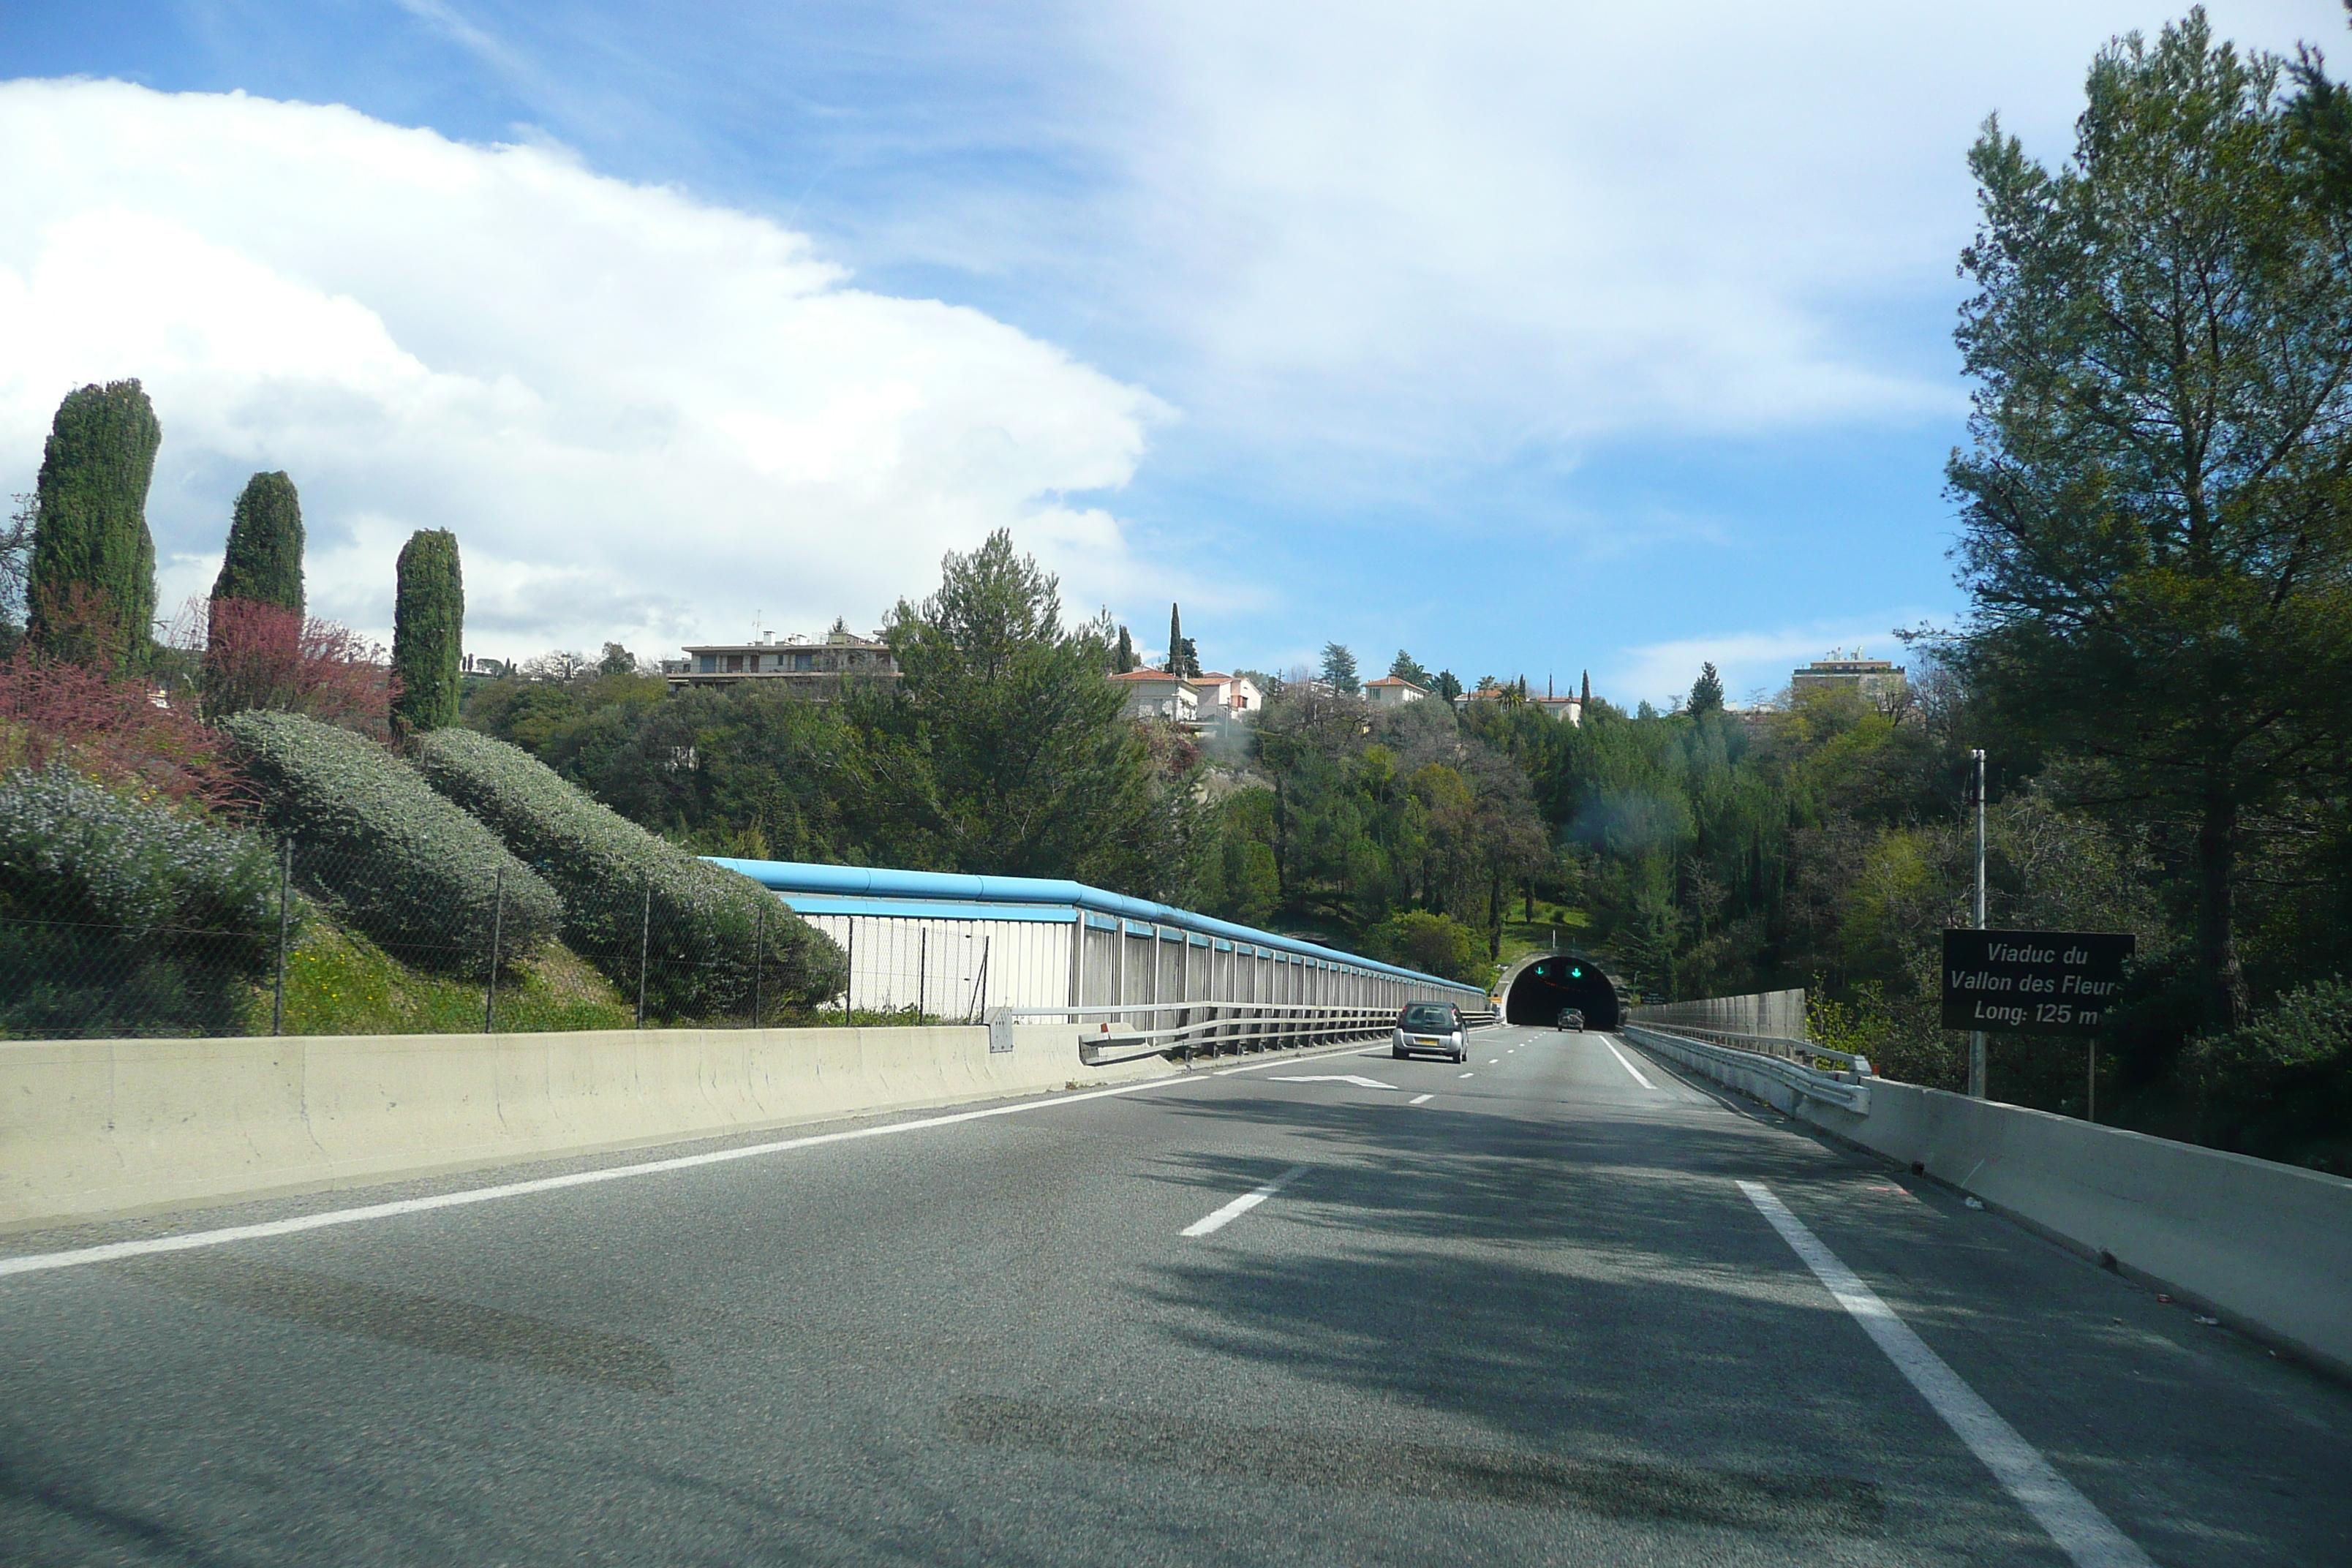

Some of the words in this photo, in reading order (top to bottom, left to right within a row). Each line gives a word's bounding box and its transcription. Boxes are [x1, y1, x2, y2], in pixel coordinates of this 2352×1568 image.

[1988, 943, 2055, 963] Viaduc
[2063, 946, 2089, 965] du
[1951, 970, 2012, 992] Vallon
[2019, 973, 2054, 993] des
[1974, 1000, 2027, 1026] Long:
[2036, 1003, 2072, 1023] 125
[2078, 1011, 2098, 1025] m
